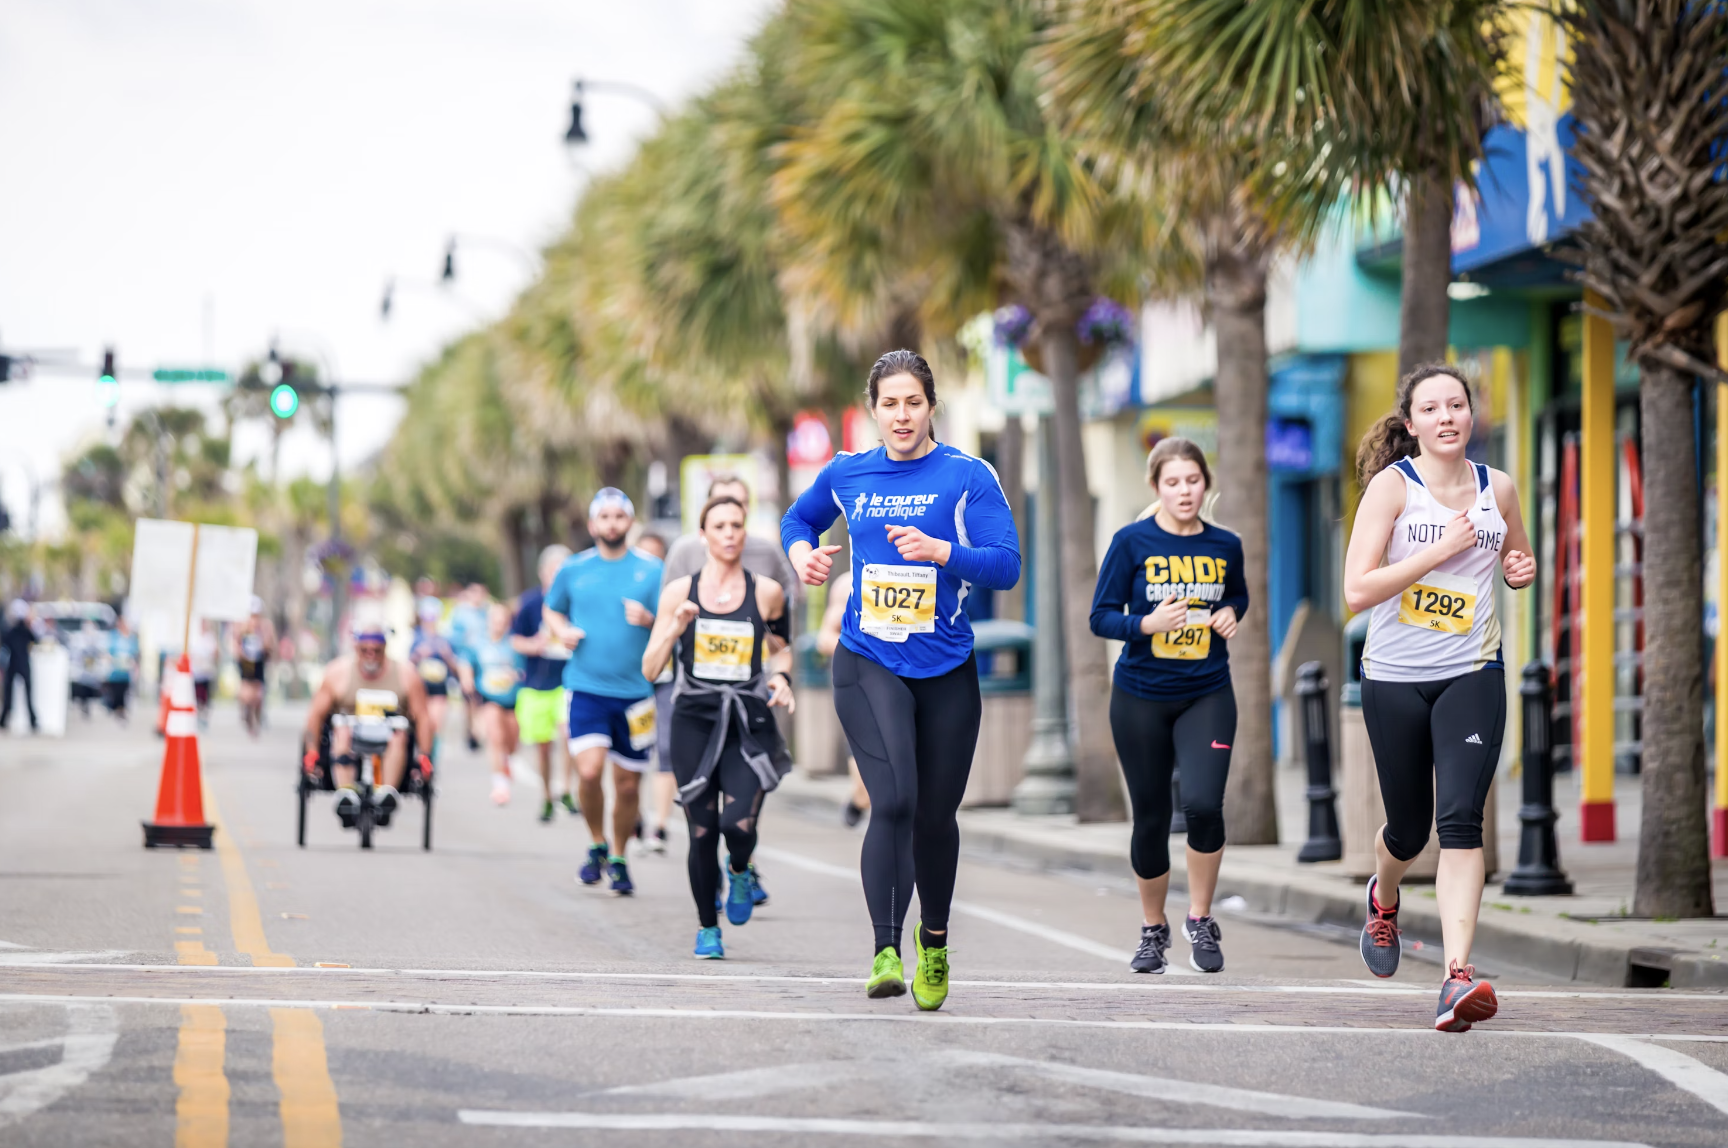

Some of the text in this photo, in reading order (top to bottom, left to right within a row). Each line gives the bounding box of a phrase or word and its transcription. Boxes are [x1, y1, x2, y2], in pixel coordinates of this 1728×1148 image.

[869, 492, 938, 506] le coureur
[865, 505, 926, 520] nordique
[1474, 529, 1501, 551] AME
[872, 585, 926, 610] 1027
[1145, 582, 1185, 602] CROSS
[1413, 589, 1466, 619] 1292
[891, 614, 902, 623] 5K
[1429, 620, 1441, 629] 5K
[708, 637, 738, 654] 567
[1165, 628, 1204, 646] 1297
